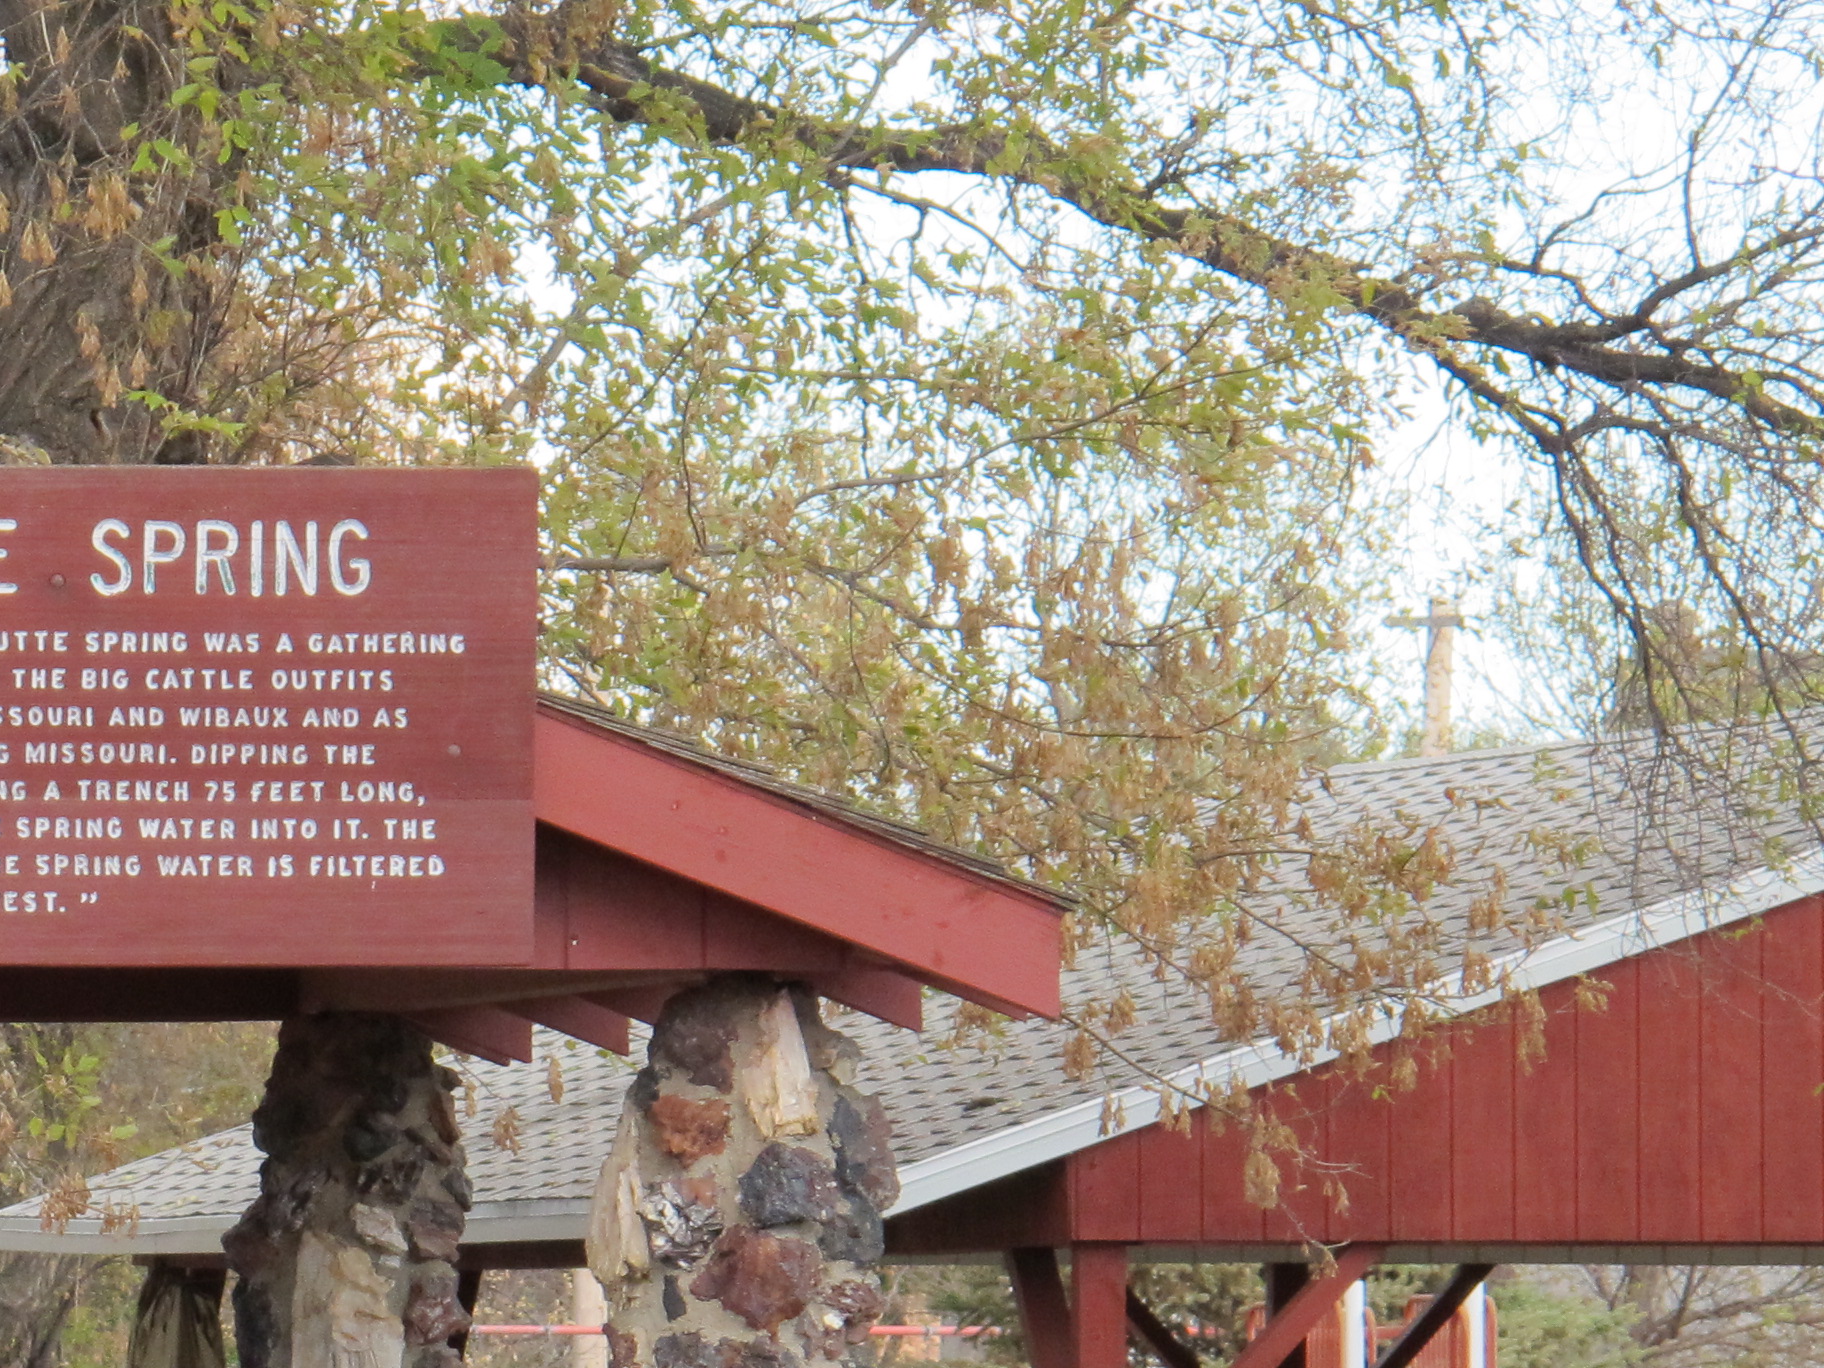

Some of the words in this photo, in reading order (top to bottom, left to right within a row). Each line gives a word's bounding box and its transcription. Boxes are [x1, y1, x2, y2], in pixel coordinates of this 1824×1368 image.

[89, 518, 371, 598] SPRING
[84, 631, 188, 654] SPRING
[203, 632, 260, 654] WAS
[275, 632, 293, 654] A
[307, 630, 466, 655] GATHERING
[12, 667, 66, 690] THE
[80, 668, 129, 691] BIG
[145, 667, 253, 691] CATTLE
[271, 669, 393, 692] OUTFITS
[108, 706, 164, 727] AND
[179, 706, 289, 729] WIBAUX
[301, 707, 360, 729] AND
[372, 707, 408, 729] AS
[25, 741, 177, 765] MISSOURI.
[191, 743, 308, 765] DIPPING
[323, 743, 375, 766] THE
[43, 780, 61, 802] A
[77, 779, 189, 804] TRENCH
[204, 780, 236, 803] 75
[250, 780, 325, 803] FEET
[340, 780, 426, 807] LONG,
[16, 816, 122, 840] SPRING
[138, 817, 235, 840] WATER
[250, 818, 317, 840] INTO
[333, 818, 369, 840] IT.
[383, 818, 436, 841] THE
[35, 853, 141, 877] SPRING
[156, 854, 254, 877] WATER
[267, 854, 294, 878] IS
[309, 854, 445, 878] FILTERED
